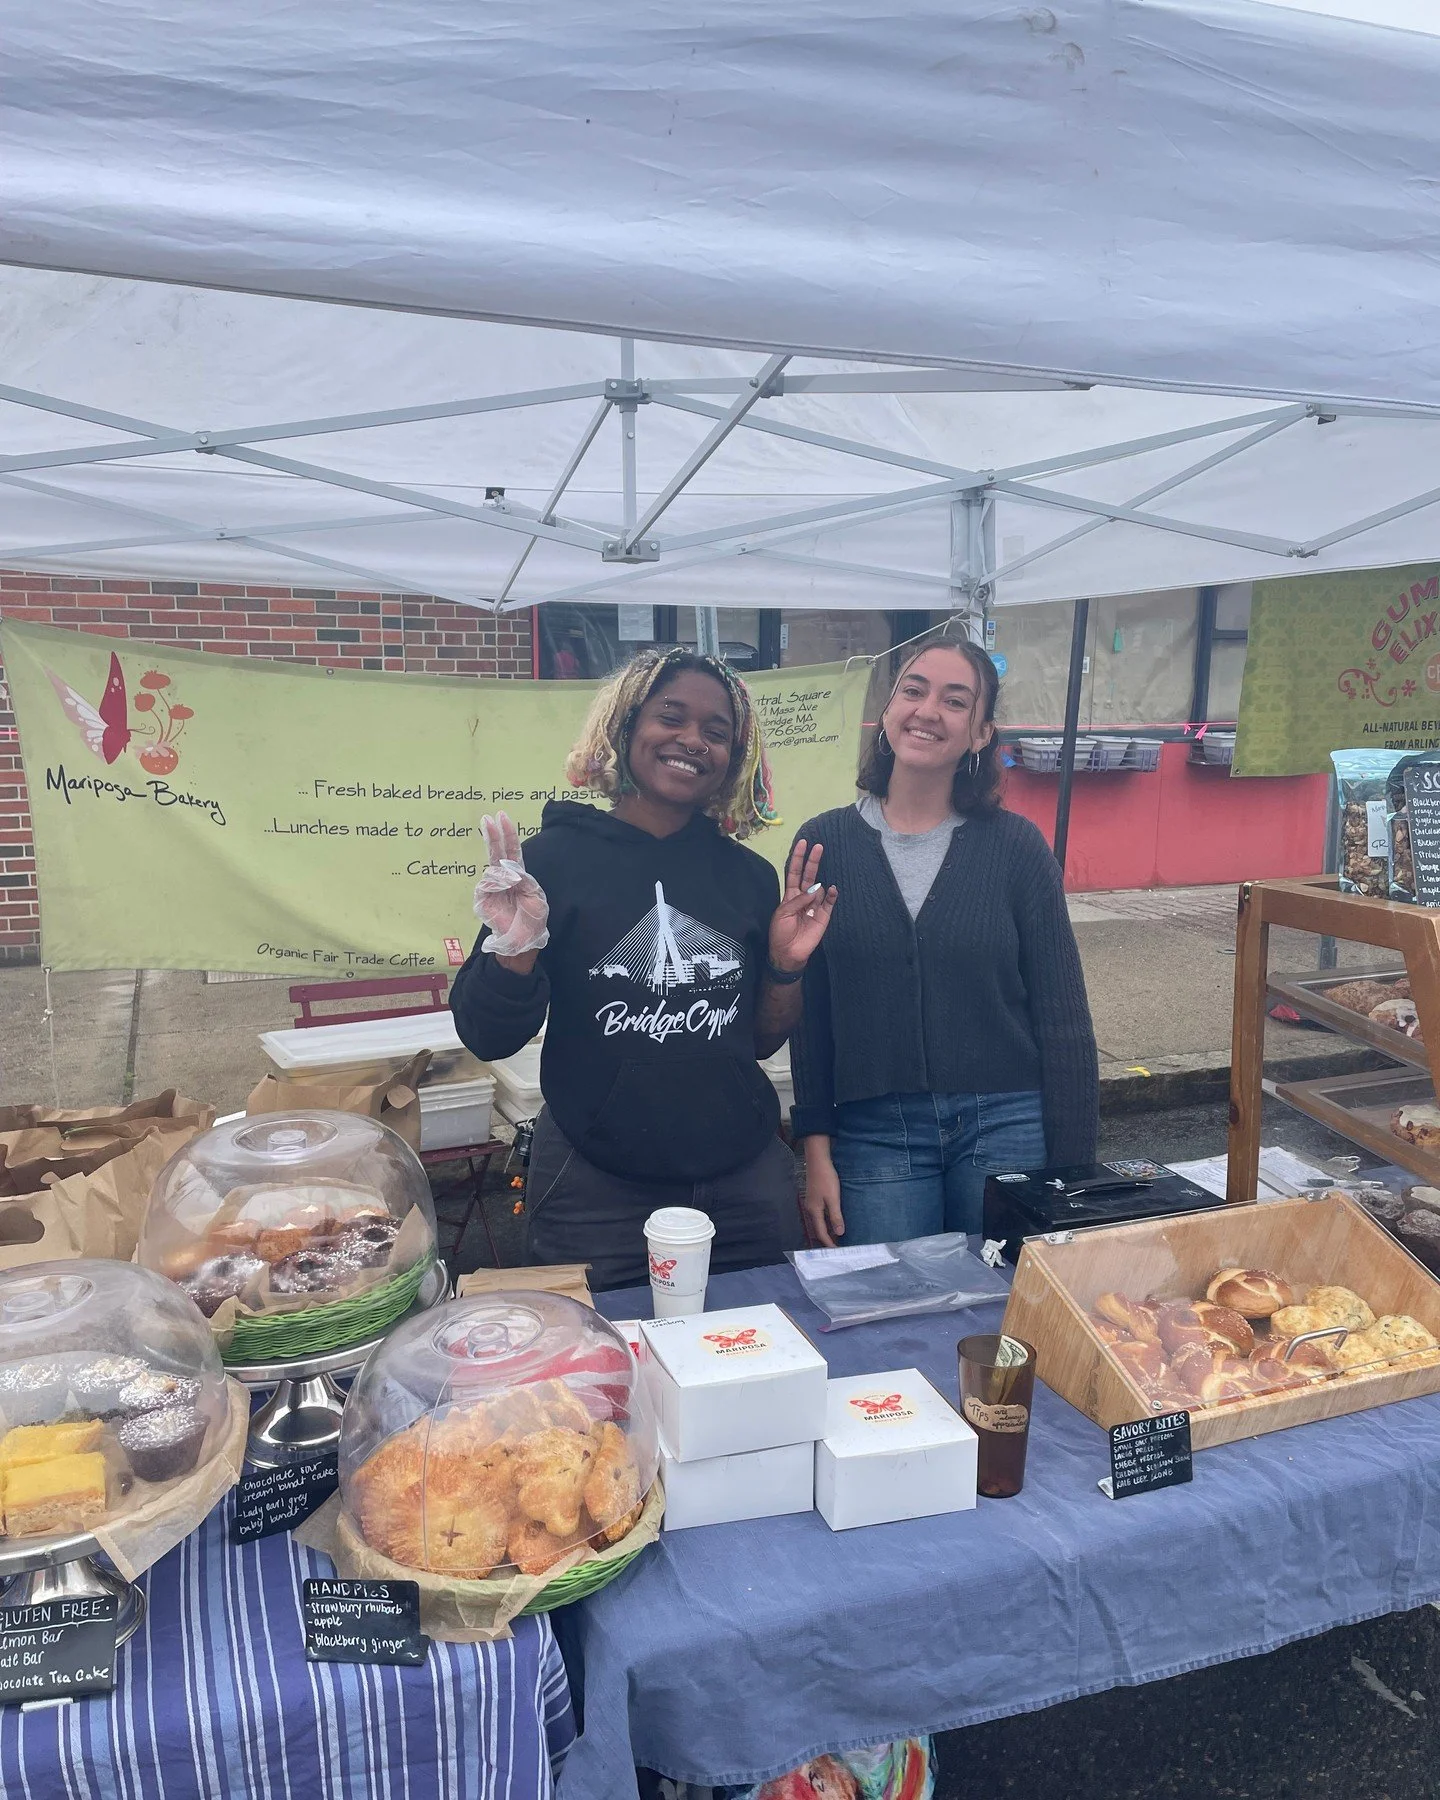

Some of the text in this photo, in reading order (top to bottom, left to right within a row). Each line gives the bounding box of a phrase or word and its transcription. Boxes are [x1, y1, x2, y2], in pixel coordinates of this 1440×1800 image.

[1389, 611, 1440, 664] ELIX
[756, 690, 831, 706] ntral Square
[770, 708, 795, 716] Mass
[798, 703, 818, 711] Ave
[762, 714, 813, 727] bridge MA
[1363, 720, 1440, 733] ALL-NATURAL BEV
[1384, 740, 1407, 749] FROM
[46, 764, 226, 826] Mariposa Bakery
[314, 779, 366, 798] Fresh
[373, 783, 421, 799] baked
[428, 785, 486, 801] breads,
[492, 787, 524, 803] pies
[530, 786, 556, 800] and
[561, 788, 606, 802] past
[356, 821, 398, 836] made
[404, 821, 423, 837] to
[429, 822, 472, 837] order
[406, 860, 476, 877] Catering
[257, 943, 308, 960] Organic
[313, 950, 339, 962] Fair
[344, 951, 385, 965] Trade
[389, 953, 435, 966] Coffee
[716, 1343, 766, 1354] MARIPOSA
[864, 1410, 913, 1421] MARIPOSA
[1113, 1413, 1185, 1441] SAVORY BITES
[300, 1461, 322, 1474] sour
[278, 1477, 306, 1490] bundt
[266, 1498, 284, 1511] earl
[288, 1493, 308, 1509] grey
[240, 1519, 263, 1534] baby
[366, 1602, 402, 1614] rhubarb
[42, 1630, 64, 1645] Bar
[371, 1638, 405, 1654] ginger
[0, 1651, 44, 1668] ate Bar
[49, 1670, 71, 1684] Tea
[75, 1666, 109, 1681] Cake
